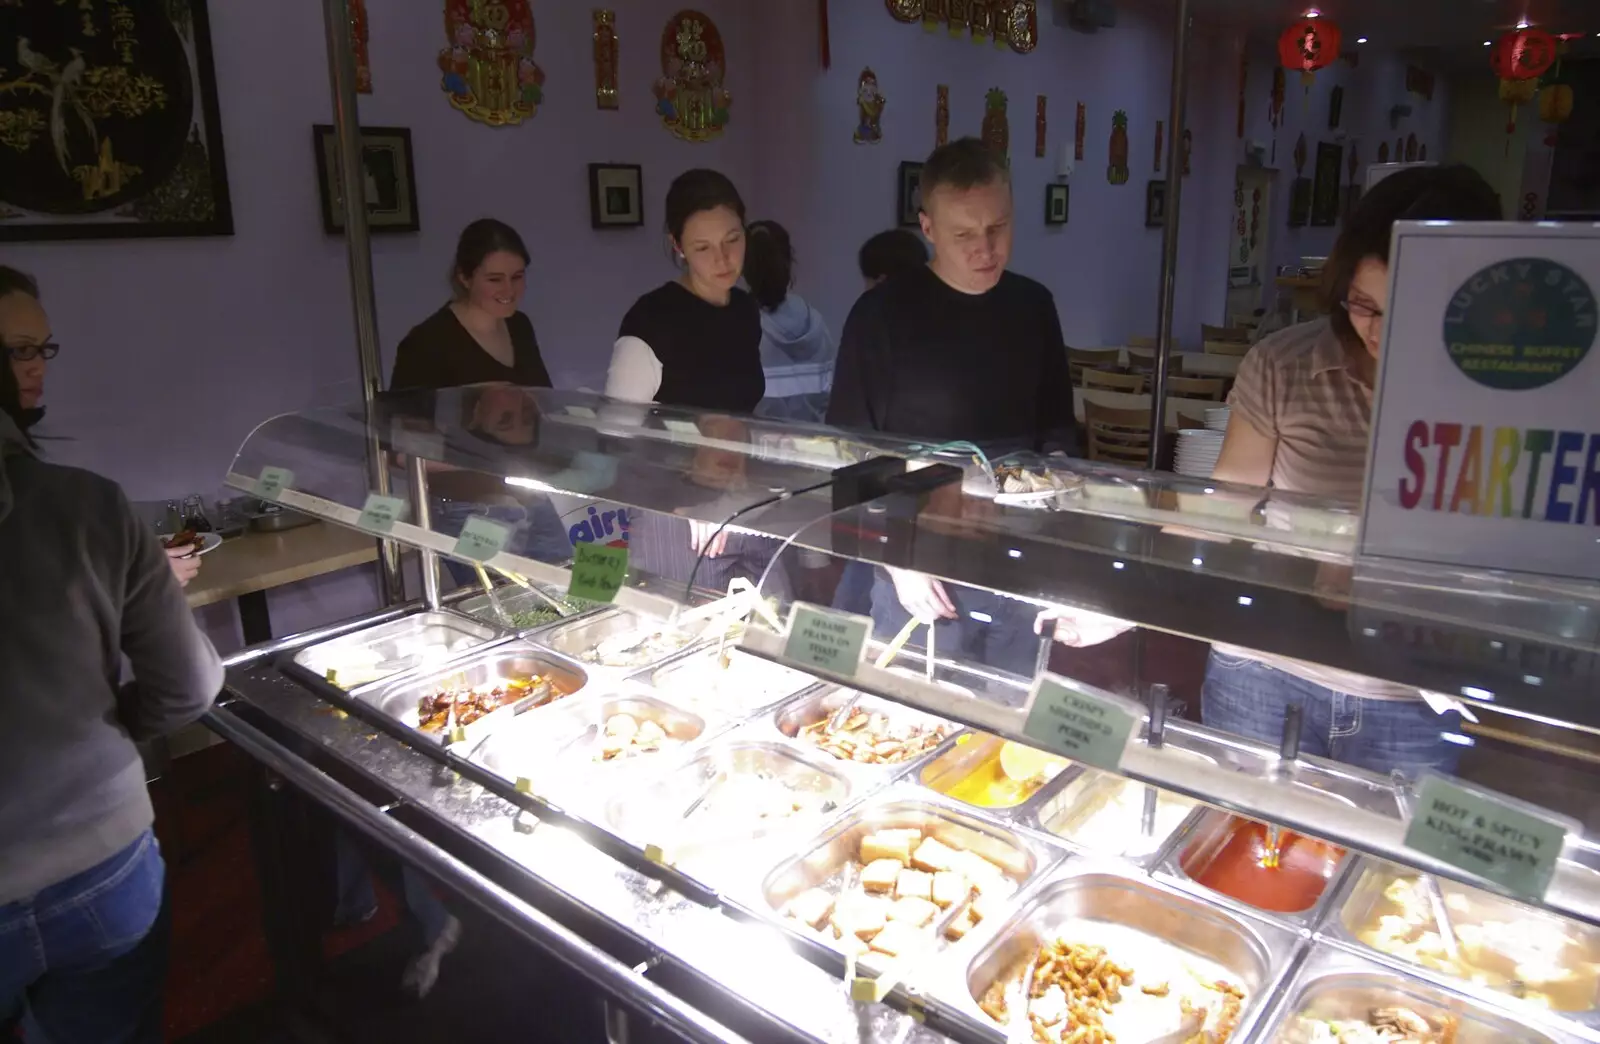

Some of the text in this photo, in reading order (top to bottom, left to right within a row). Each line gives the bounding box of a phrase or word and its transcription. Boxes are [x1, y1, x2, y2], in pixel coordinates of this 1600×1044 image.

[1445, 263, 1531, 325] LUCKY
[1544, 268, 1596, 328] STAR
[1450, 342, 1584, 359] CHINESE BUFFET
[1460, 358, 1565, 374] RESTAURANT
[809, 642, 839, 658] TOAST
[1062, 694, 1105, 717] CRISPY
[1057, 722, 1091, 745] PORK
[1424, 814, 1470, 842] KING
[1431, 797, 1545, 850] HOT & SPICY
